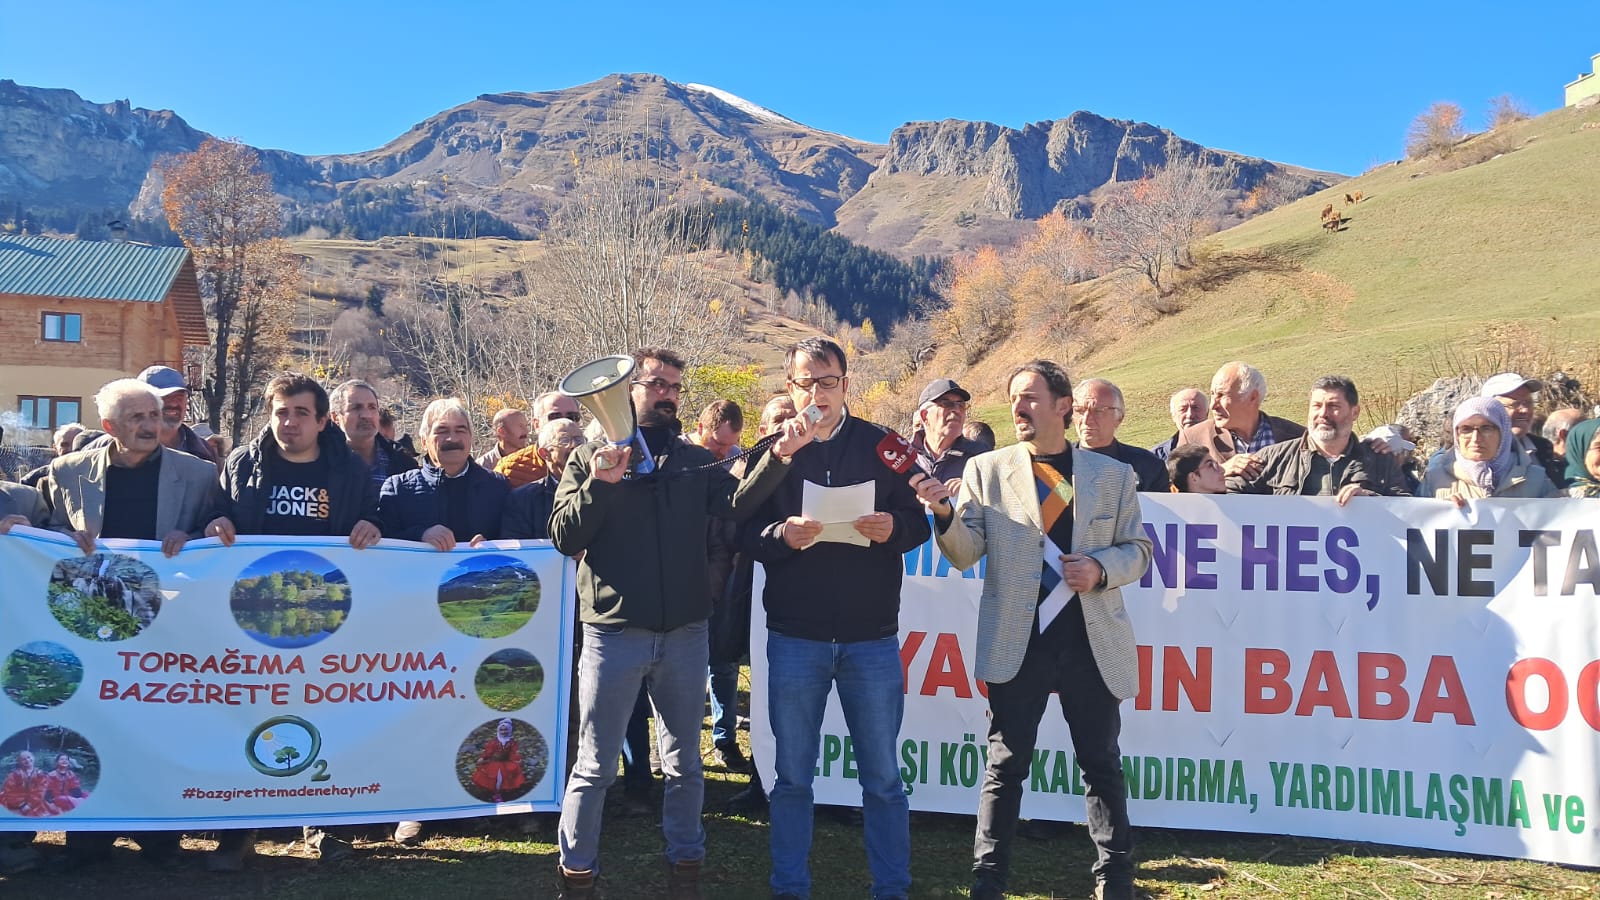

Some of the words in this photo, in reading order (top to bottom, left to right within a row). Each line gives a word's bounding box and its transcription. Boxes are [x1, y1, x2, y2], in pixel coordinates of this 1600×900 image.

[269, 486, 329, 502] JACK&
[266, 500, 329, 518] JONES
[1140, 523, 1217, 589] NE
[1242, 525, 1380, 611] HES,
[1407, 528, 1495, 597] NE
[1518, 529, 1600, 596] TA
[118, 649, 305, 675] TOPRAĞIMA
[99, 679, 290, 705] BAZGİRET'E
[304, 679, 466, 704] DOKUNMA.
[1245, 647, 1476, 726] BABA
[182, 783, 381, 801] #bazgirettemadenehayır#
[1269, 761, 1532, 837] YARDIMLAŞMA
[1542, 793, 1586, 834] ve
